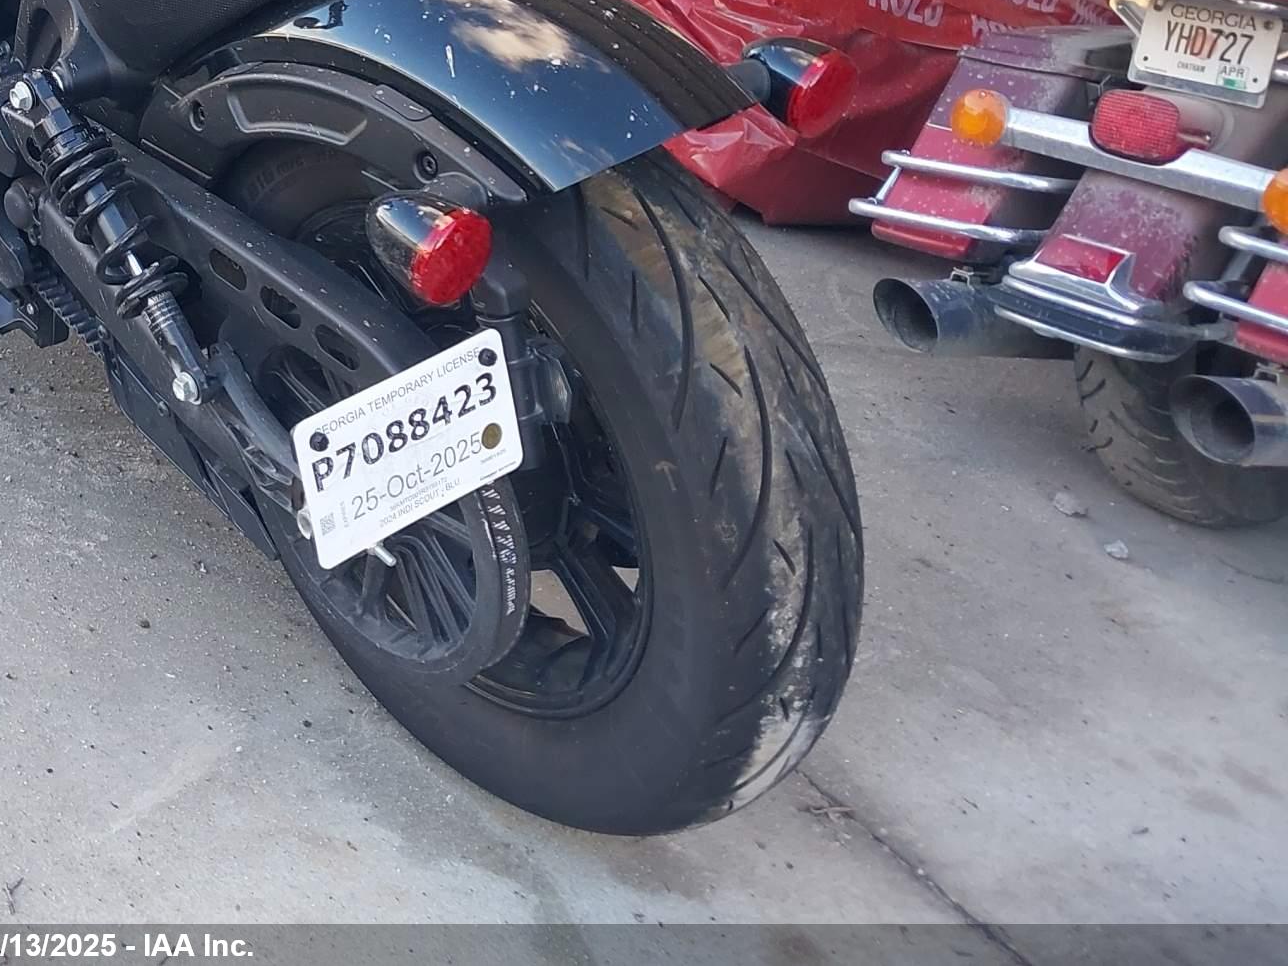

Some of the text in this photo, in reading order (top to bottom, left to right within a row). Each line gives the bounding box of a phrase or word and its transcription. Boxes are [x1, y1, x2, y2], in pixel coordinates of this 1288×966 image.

[1170, 3, 1257, 31] GEORGIA
[1164, 20, 1254, 65] YHD727
[1220, 65, 1245, 79] APR
[368, 370, 437, 414] TEMPORARY
[437, 346, 481, 379] LICENSE
[312, 372, 498, 492] P7088423
[351, 431, 483, 520] 25-Oct-2025
[414, 488, 440, 509] SCOUT
